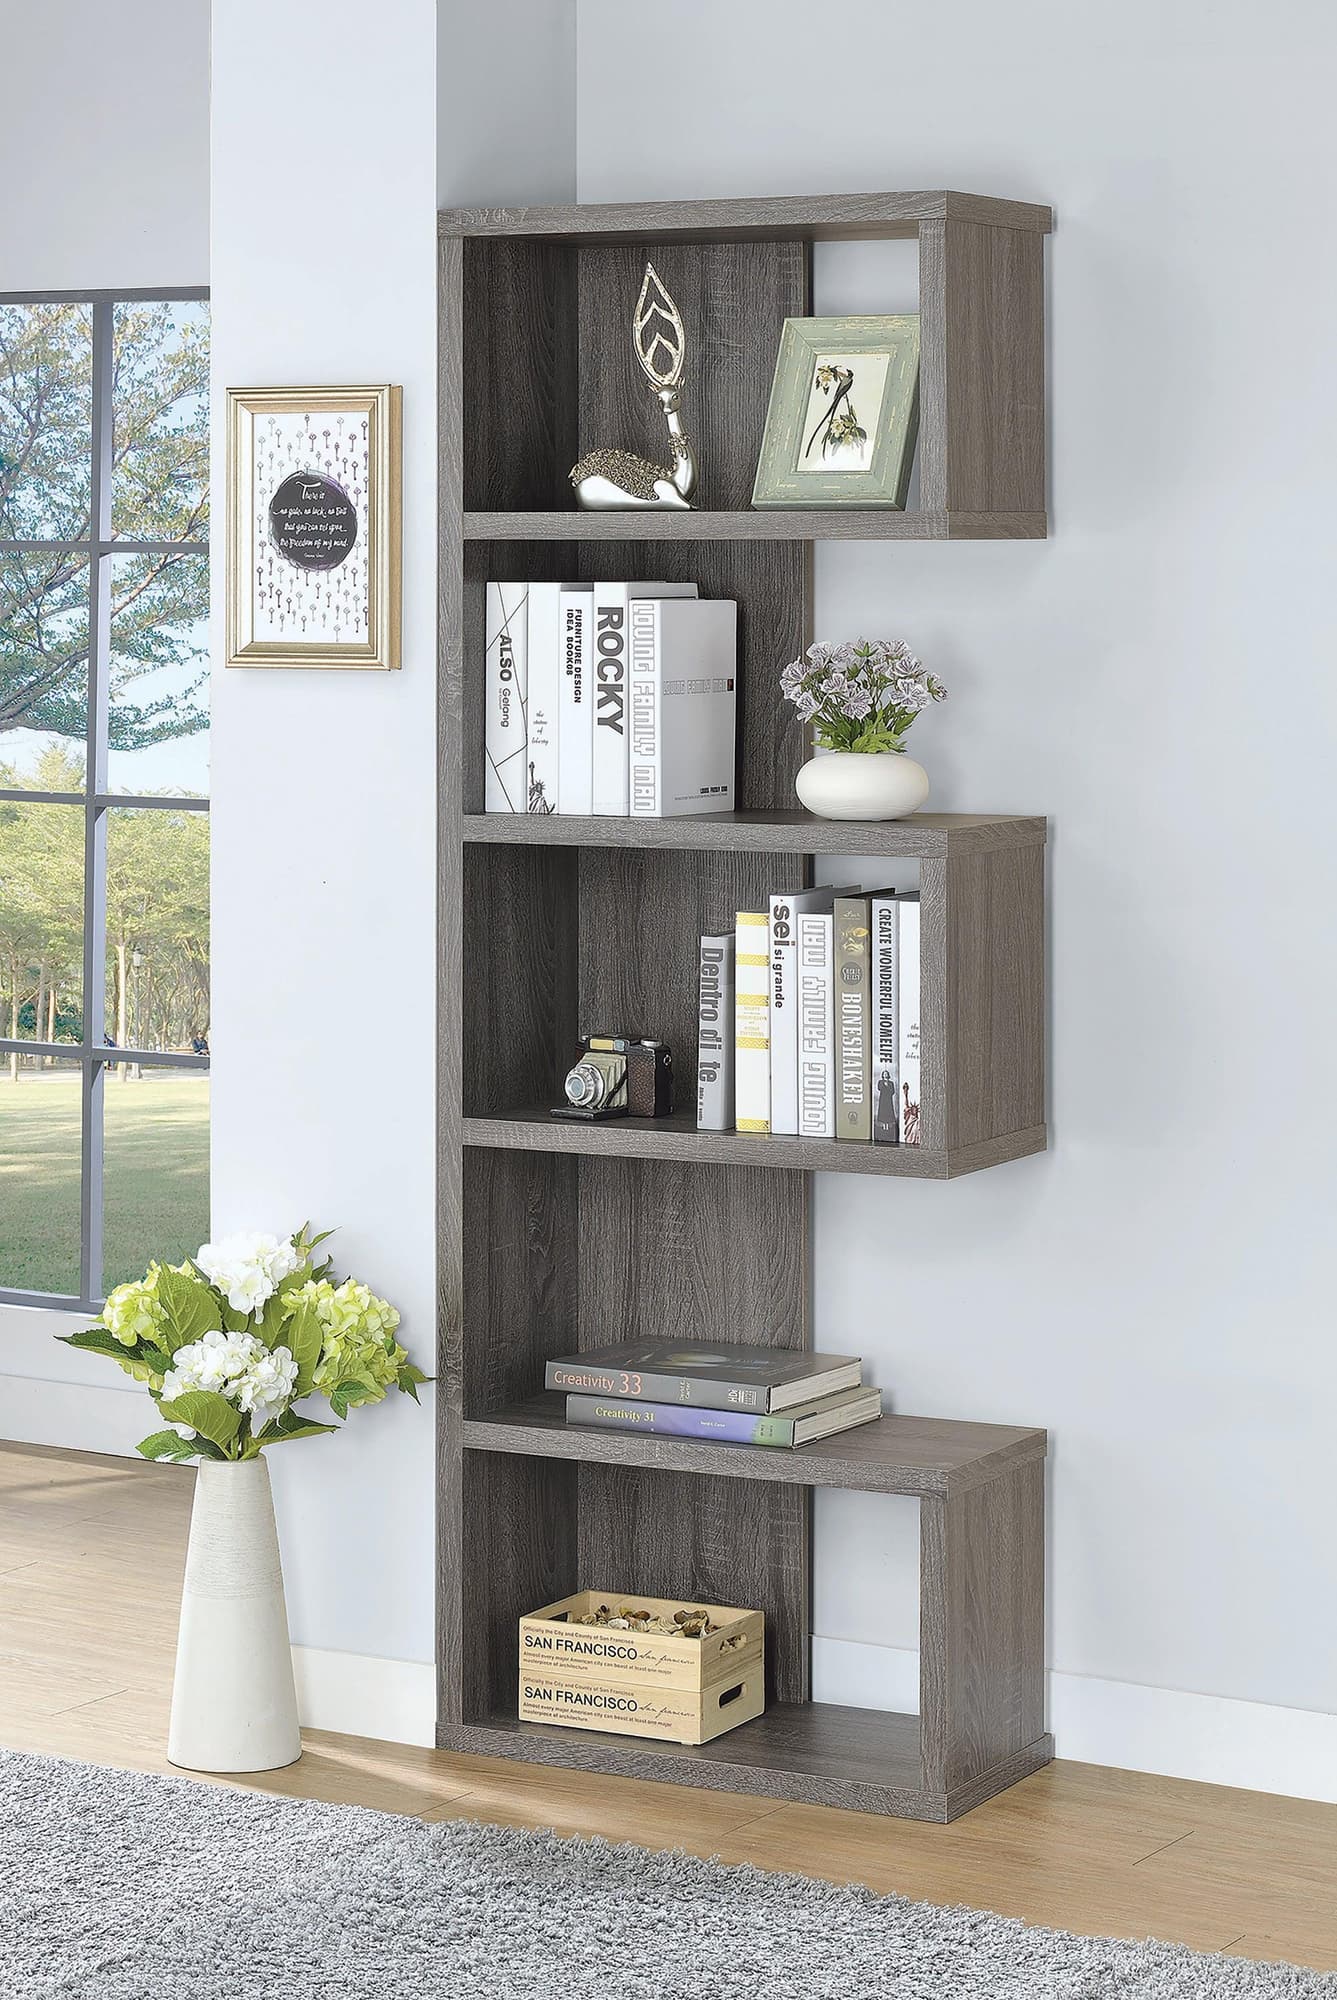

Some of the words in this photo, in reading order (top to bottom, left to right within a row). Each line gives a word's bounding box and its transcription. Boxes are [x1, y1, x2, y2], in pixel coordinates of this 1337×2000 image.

[566, 609, 574, 632] IDEA
[574, 609, 582, 664] FURNITURE
[632, 604, 655, 672] LOVING
[500, 634, 512, 682] ALSO
[597, 607, 624, 735] ROCKY
[574, 666, 582, 704] DESIGN
[500, 688, 511, 728] Gelang
[633, 681, 655, 756] FAMILY
[773, 904, 795, 946] sei
[879, 908, 892, 944] CREATE
[774, 949, 784, 960] si
[700, 948, 723, 1021] Dentro
[772, 964, 785, 1008] grande
[879, 948, 892, 1010] WONDERFUL
[802, 976, 826, 1053] FAMILY
[700, 1029, 722, 1050] di
[842, 992, 863, 1104] BONESHAKER
[879, 1013, 892, 1064] HOMELIFE
[699, 1062, 720, 1082] te
[803, 1062, 826, 1133] LOVING
[554, 1371, 615, 1392] Creativity
[619, 1373, 642, 1395] 33
[595, 1407, 642, 1423] Creativity
[644, 1412, 655, 1422] 31
[525, 1635, 552, 1650] SAN
[556, 1639, 638, 1660] FRANCISCO
[574, 1632, 592, 1640] County
[525, 1686, 552, 1700] SAN
[556, 1690, 638, 1712] FRANCISCO
